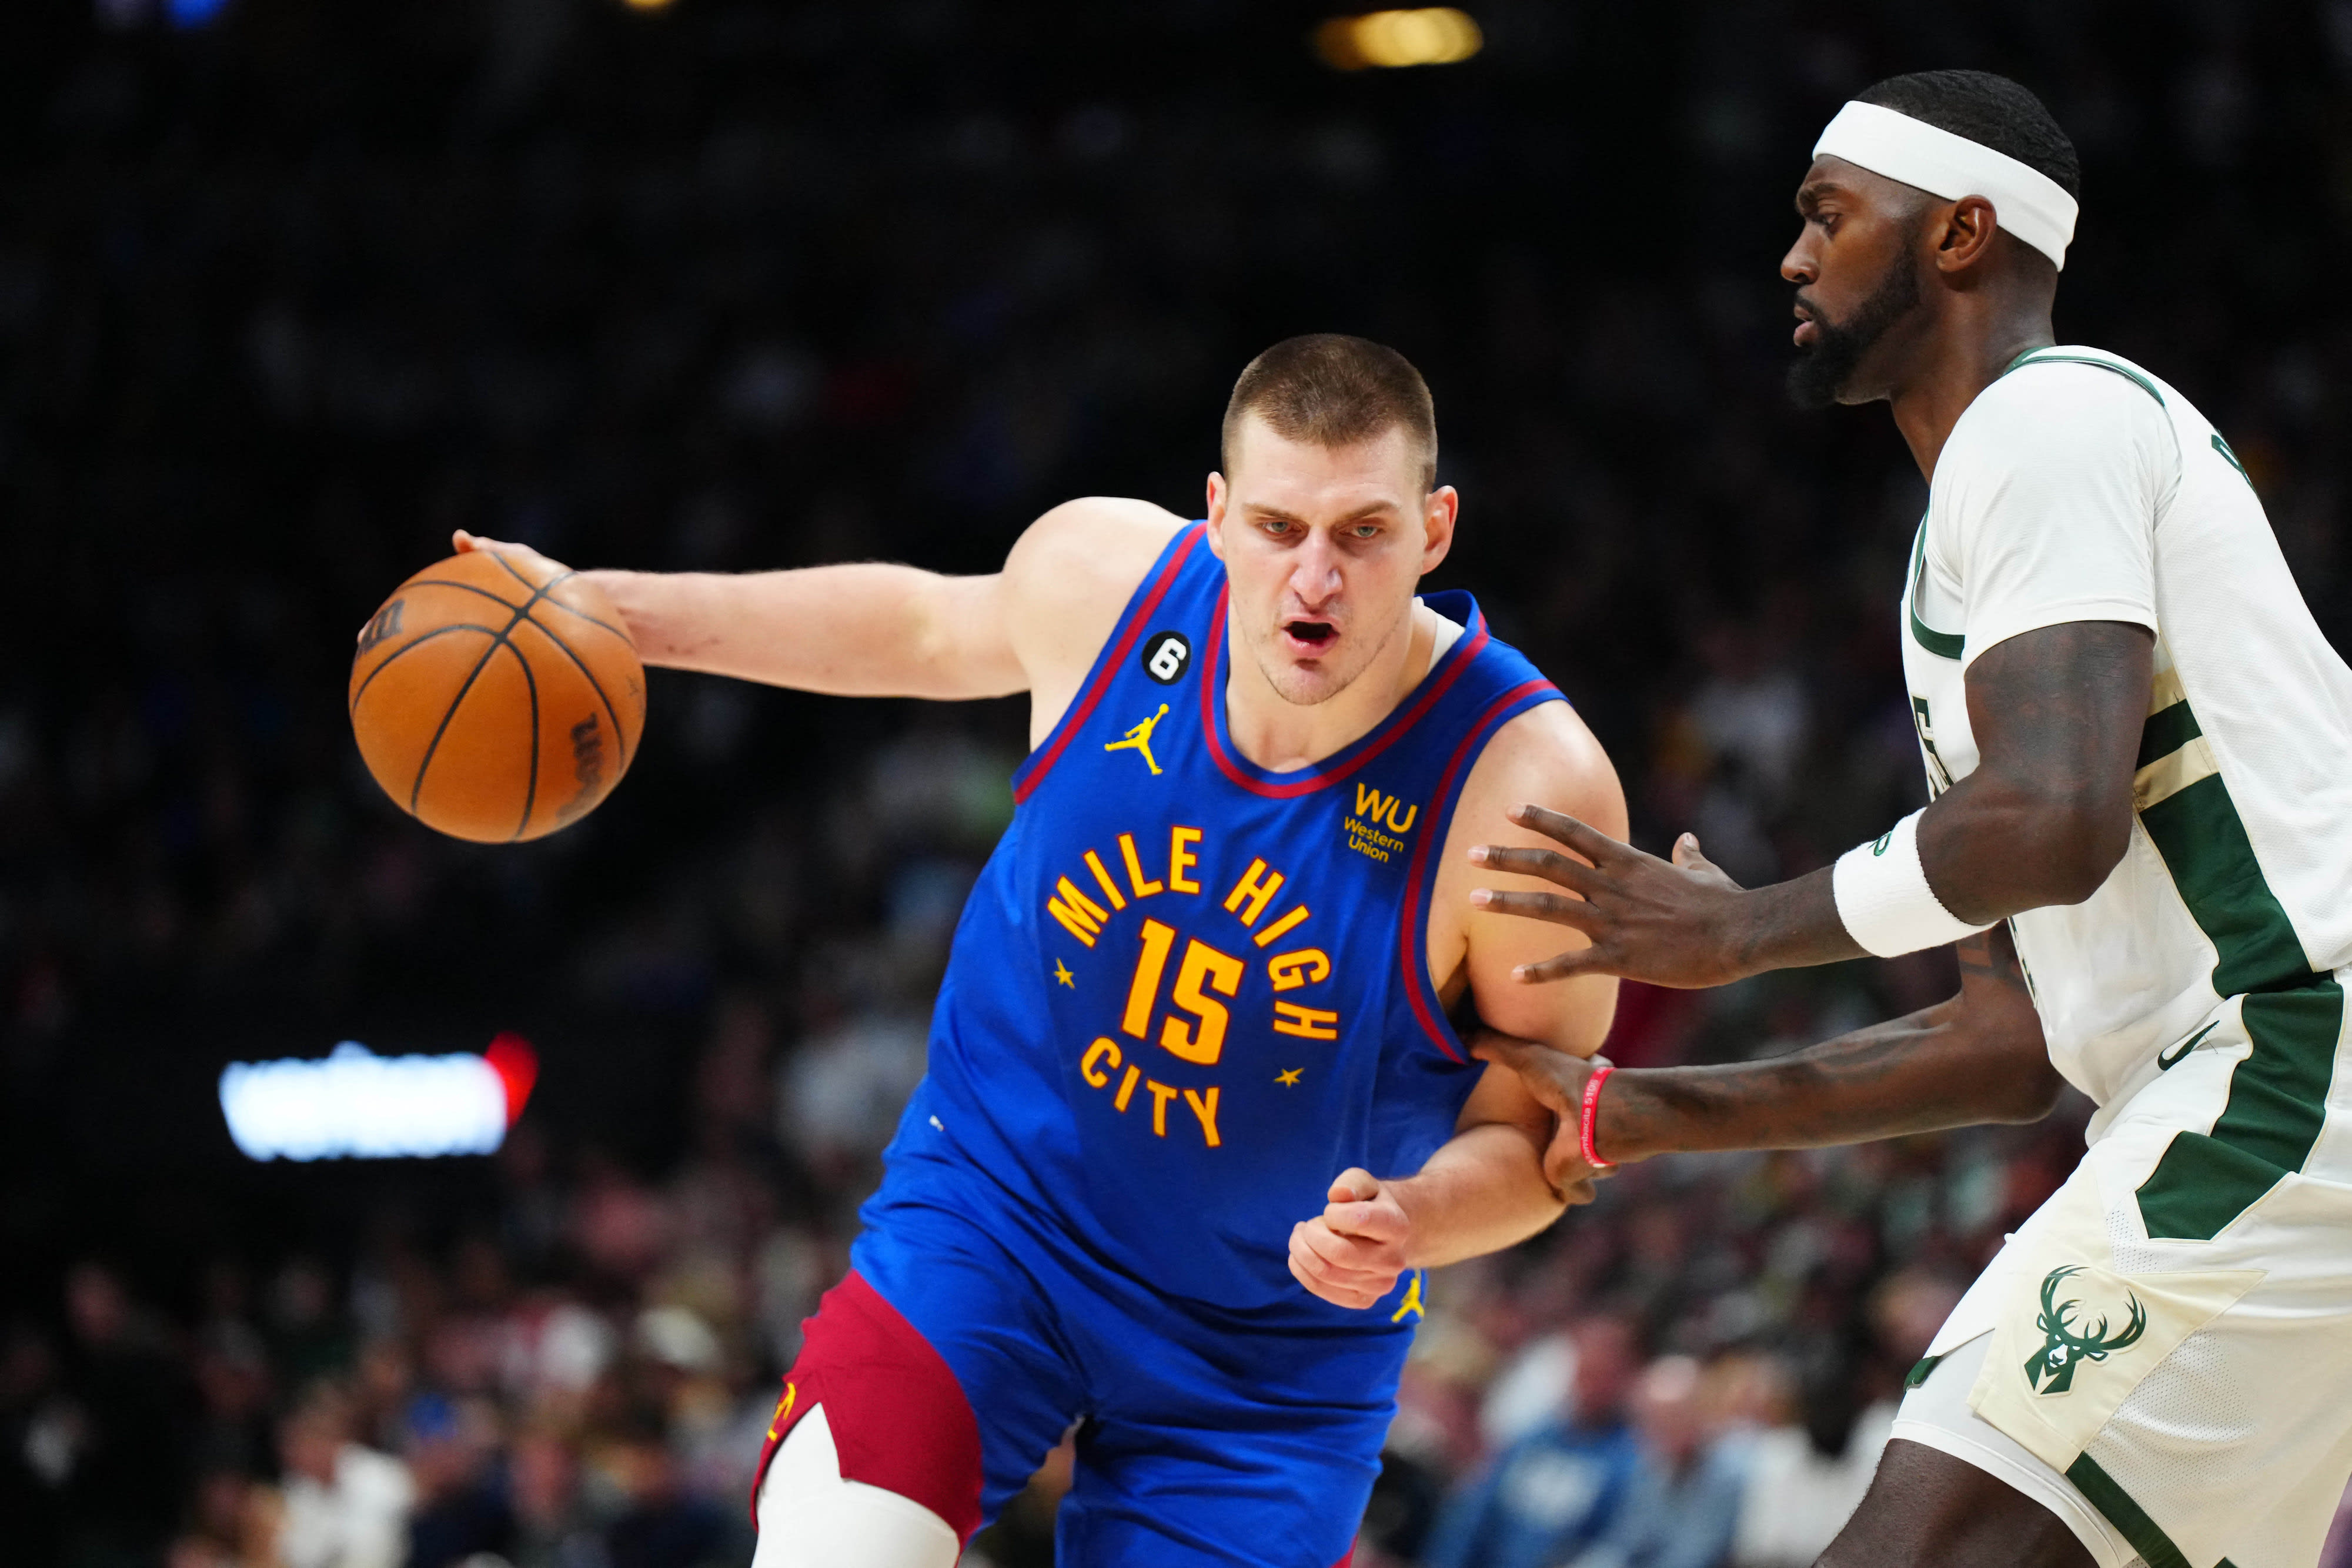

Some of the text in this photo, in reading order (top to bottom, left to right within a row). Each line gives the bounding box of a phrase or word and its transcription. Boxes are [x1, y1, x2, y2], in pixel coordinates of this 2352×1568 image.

[1149, 637, 1187, 680] 6
[1355, 782, 1418, 833] WU
[1344, 816, 1404, 852] Western
[1348, 834, 1389, 863] Union
[1045, 825, 1339, 1041] MILE HIGH
[1120, 916, 1246, 1066] 15
[1080, 1035, 1222, 1148] CITY
